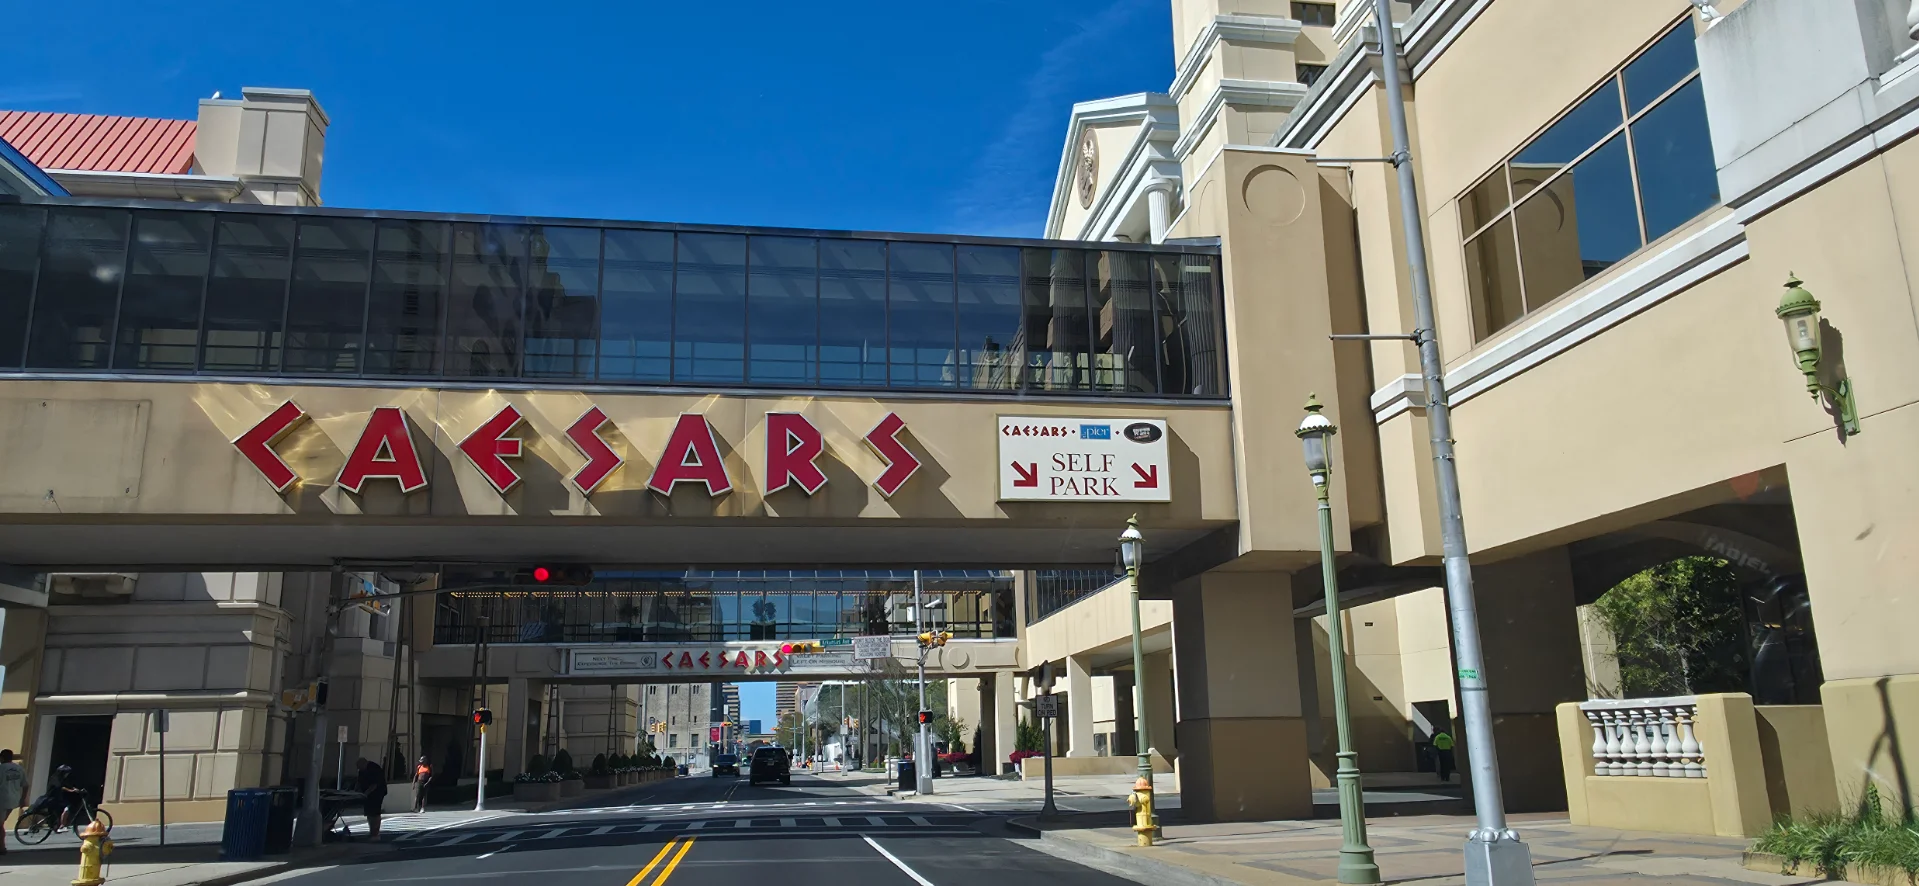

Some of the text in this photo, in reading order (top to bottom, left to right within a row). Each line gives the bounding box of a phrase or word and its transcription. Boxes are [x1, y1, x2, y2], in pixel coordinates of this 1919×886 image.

[1002, 424, 1067, 437] CAESARS
[231, 399, 922, 498] CAESARS
[1051, 452, 1116, 472] SELF
[1049, 476, 1121, 496] PARK
[661, 650, 784, 669] CAESARS
